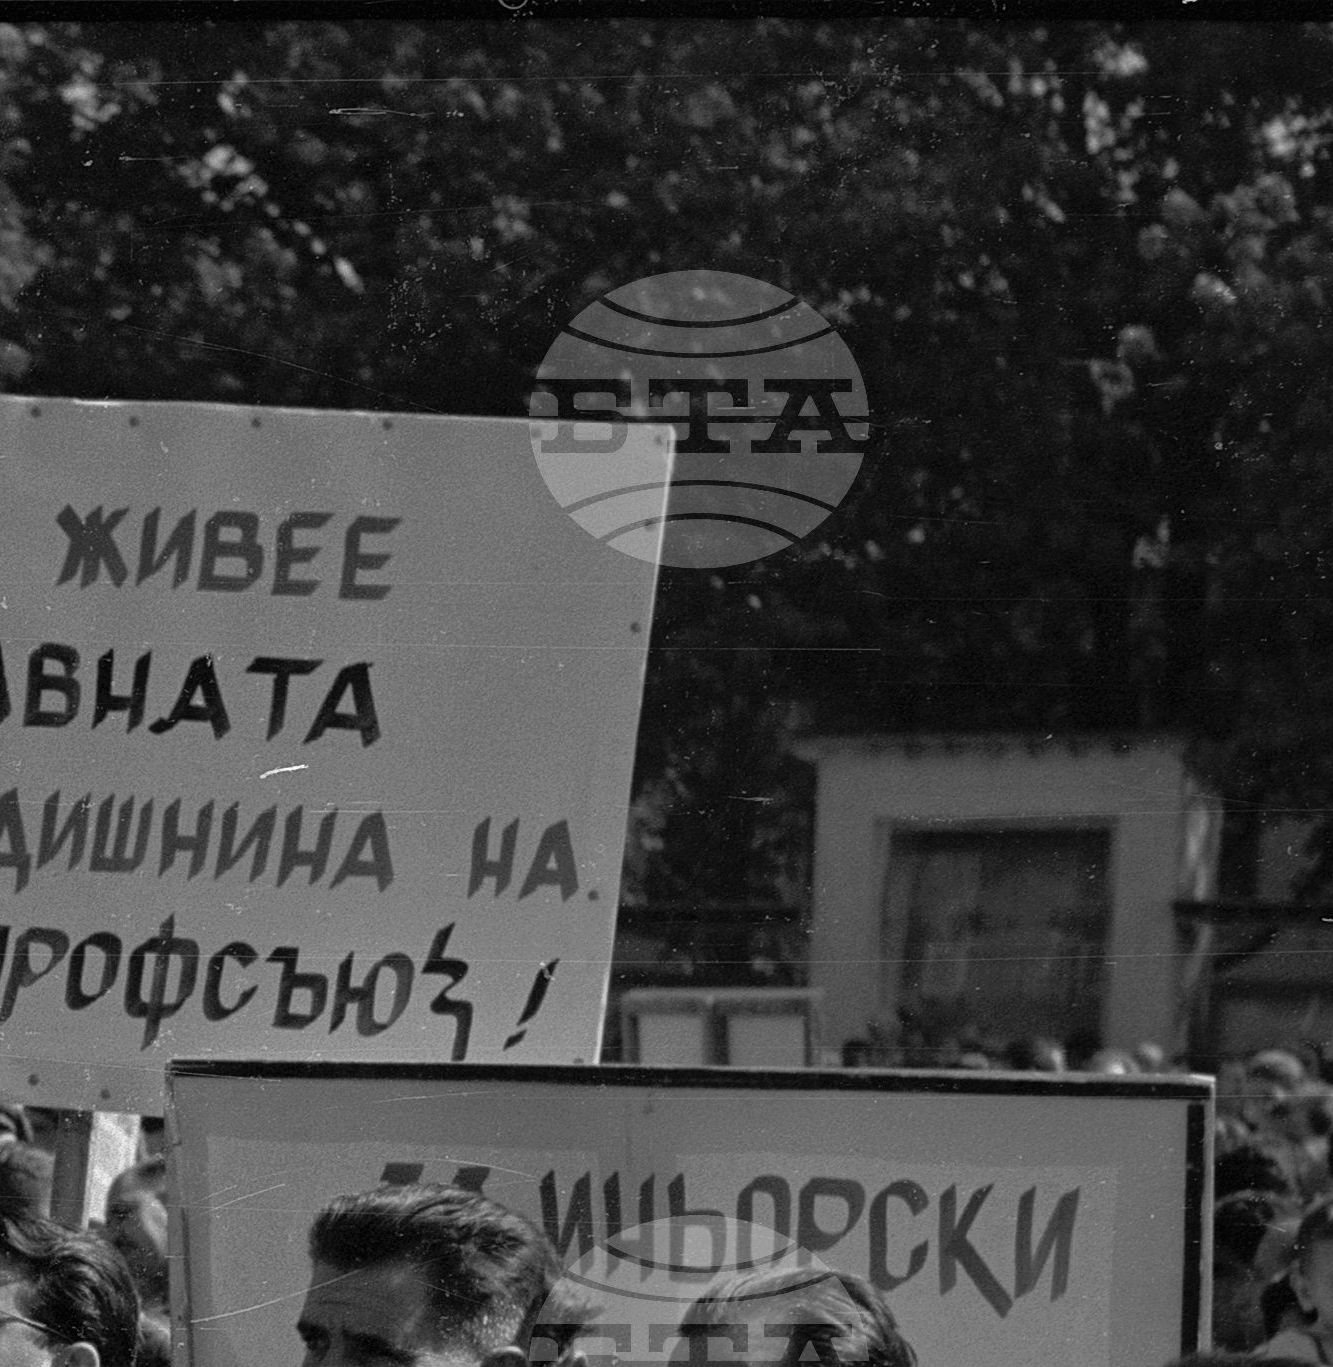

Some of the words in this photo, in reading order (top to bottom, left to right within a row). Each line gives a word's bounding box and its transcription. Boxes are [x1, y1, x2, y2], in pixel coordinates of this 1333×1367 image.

[55, 505, 404, 600] ЖИВЕЕ
[467, 816, 581, 902] НА
[379, 1161, 1083, 1318] ИНЬОРСКИ
